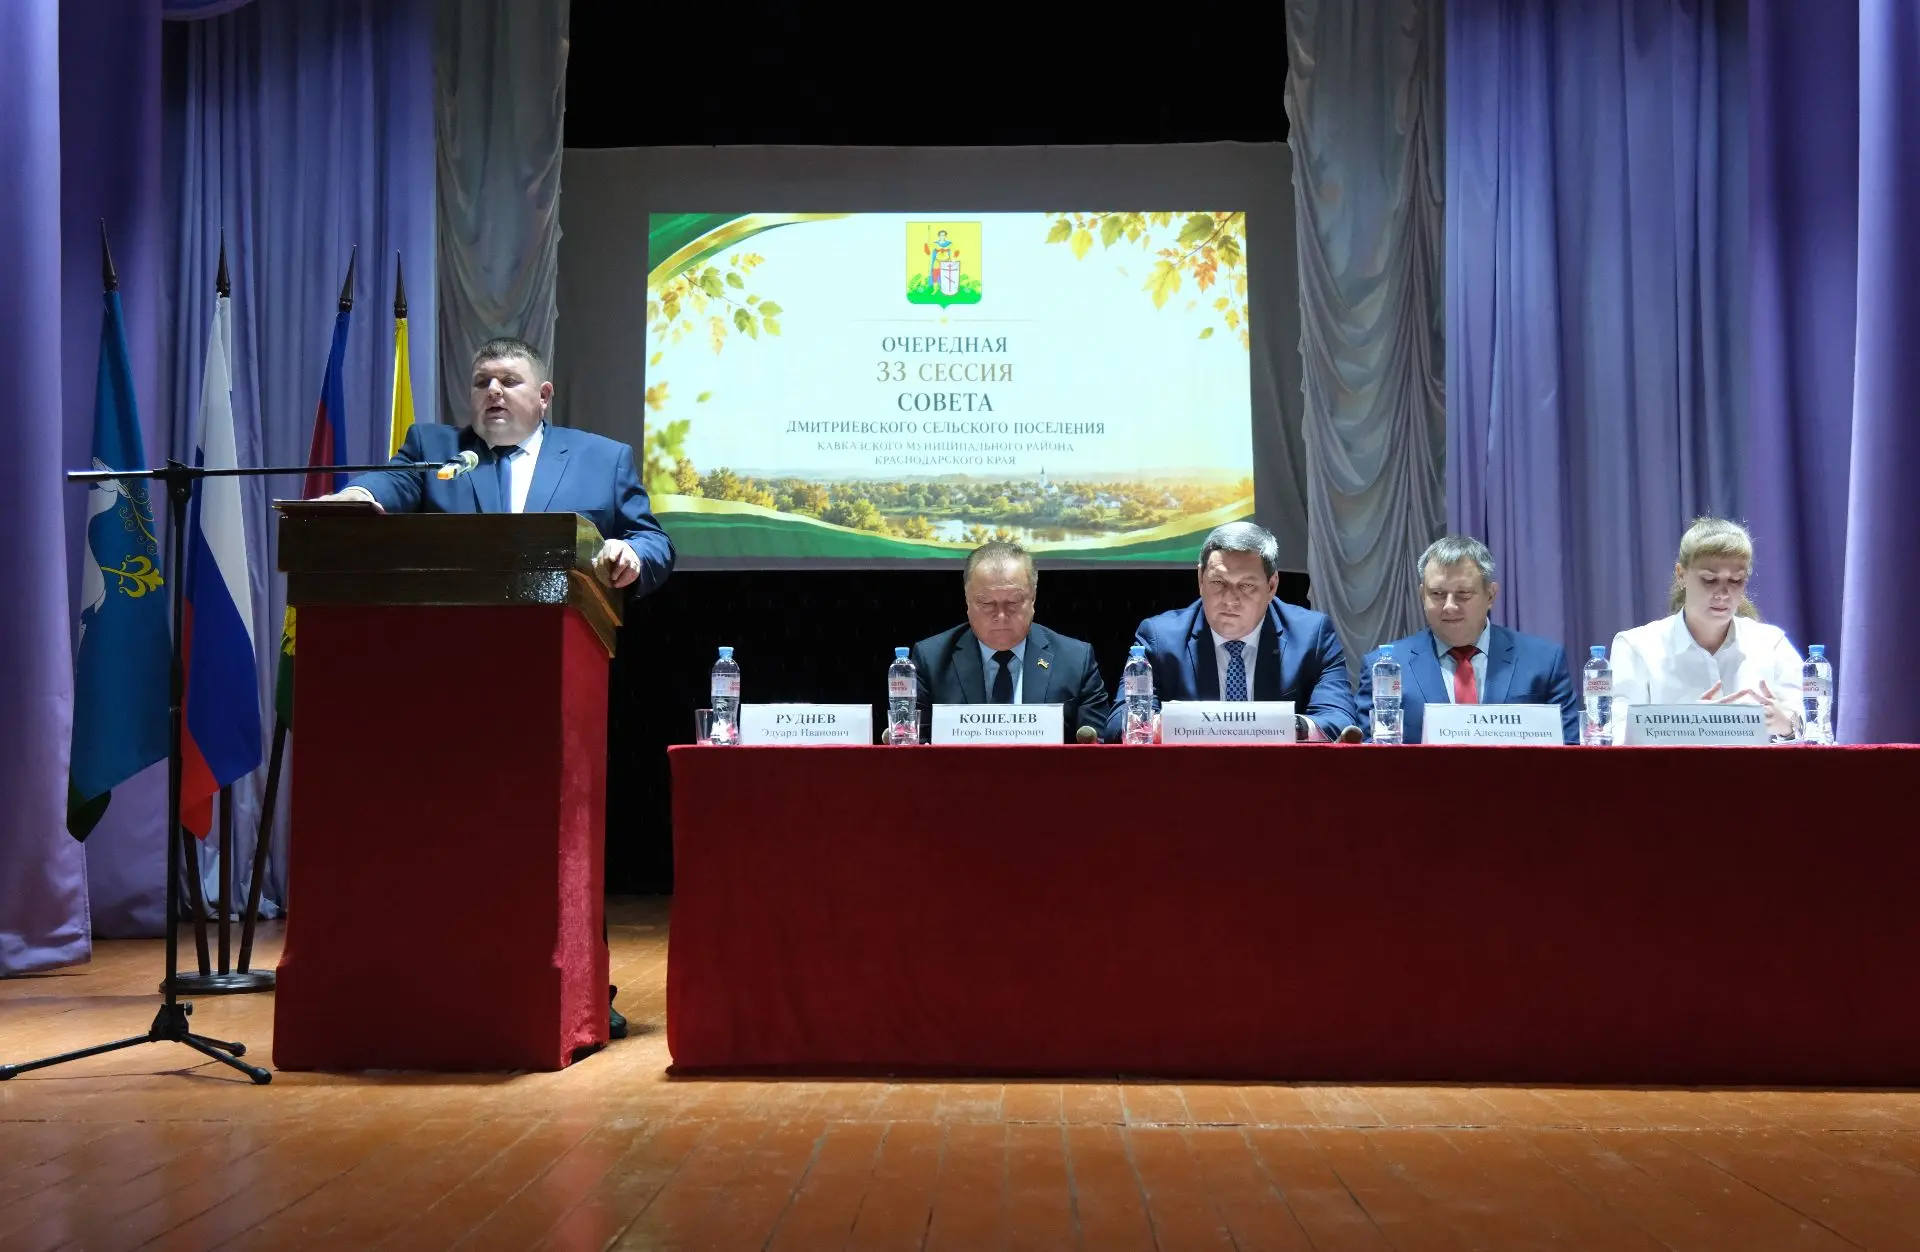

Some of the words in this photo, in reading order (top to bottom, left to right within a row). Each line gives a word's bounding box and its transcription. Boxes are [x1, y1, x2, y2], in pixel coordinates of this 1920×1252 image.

[881, 336, 1008, 354] ОЧЕРЕДНАЯ
[876, 361, 907, 382] 33
[918, 362, 1013, 382] СЕССИЯ
[897, 392, 994, 412] СОВЕТА
[786, 420, 918, 434] ДМИТРИЕВСКОГО
[922, 421, 1009, 434] СЕЛЬСКОГО
[1013, 421, 1106, 435] ПОСЕЛЕНИЯ
[817, 440, 903, 452] КАВКАЗСКОГО
[906, 441, 1023, 453] МУНИЦИПАЛЬНОГО
[1026, 440, 1075, 453] РАЙОНА
[874, 455, 984, 466] КРАСНОДАРСКОГО
[986, 455, 1017, 466] КРАЯ
[776, 713, 837, 725] РУДНЕВ
[959, 713, 1038, 724] КОШЕЛЕВ
[1201, 711, 1257, 723] ХАНИН
[1466, 713, 1522, 725] ЛАРИН
[1635, 714, 1761, 725] ГАПРИНДАШВИЛИ
[761, 728, 798, 740] Эдуард
[801, 728, 849, 738] Иванович
[951, 728, 982, 739] Игорь
[984, 727, 1045, 739] Викторович
[1173, 726, 1204, 738] Юрий
[1207, 726, 1286, 738] Александрович
[1439, 727, 1470, 739] Юрий
[1473, 728, 1553, 740] Александрович
[1646, 727, 1696, 739] Кристина
[1698, 727, 1755, 738] Романовна
